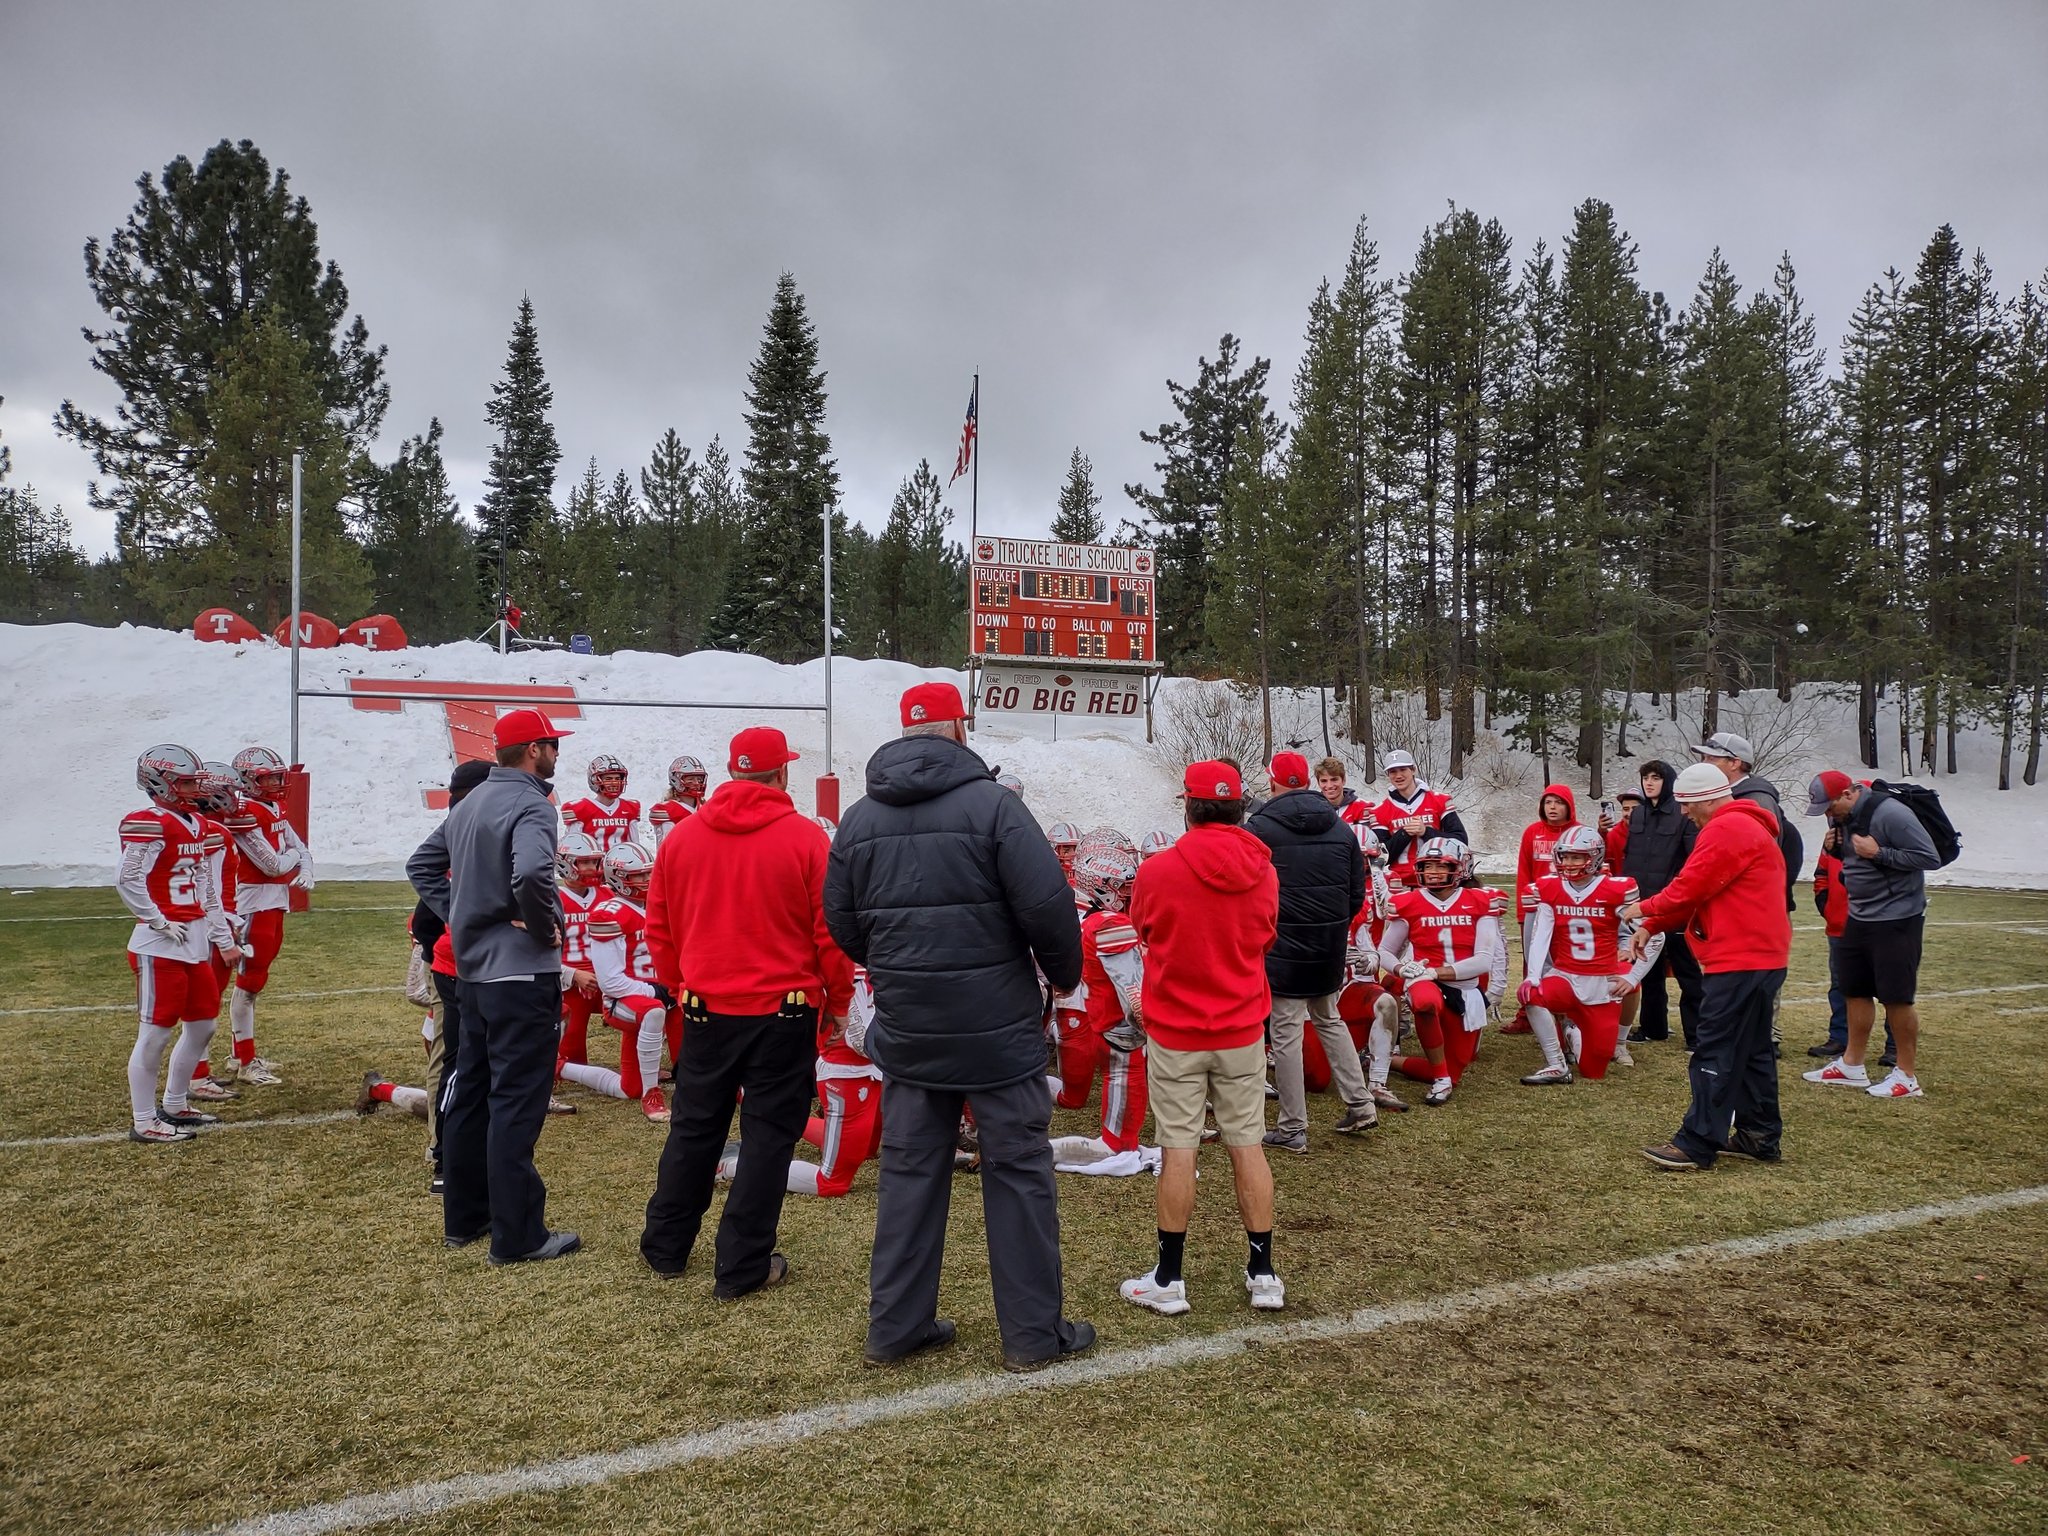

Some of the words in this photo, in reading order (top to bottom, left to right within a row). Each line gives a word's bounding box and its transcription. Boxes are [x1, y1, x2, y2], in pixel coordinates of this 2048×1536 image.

[1001, 541, 1051, 565] TRUCKEE
[1057, 546, 1081, 568] HIGH
[1087, 548, 1129, 571] SCHOOL
[974, 568, 1017, 583] TRUCKEE
[1118, 578, 1151, 591] GUEST
[976, 613, 1009, 627] DOWN
[1022, 616, 1036, 629] TO
[1041, 617, 1056, 630] GO
[1072, 618, 1096, 632] BALL
[1100, 620, 1113, 633] ON
[210, 614, 234, 634] T
[359, 627, 379, 649] T
[1127, 621, 1147, 635] QTR
[1013, 674, 1042, 686] RED
[1081, 678, 1119, 689] PRIDE
[984, 685, 1020, 710] GO
[1032, 688, 1077, 713] BIG
[1087, 691, 1139, 715] RED
[1391, 753, 1398, 761] T
[592, 817, 628, 827] TRUCKEE
[1392, 814, 1434, 829] TRUEE
[1556, 905, 1606, 917] TRUCKEE
[1420, 915, 1472, 927] TRUCKEE
[1567, 918, 1596, 961] 9
[1438, 928, 1455, 968] 1
